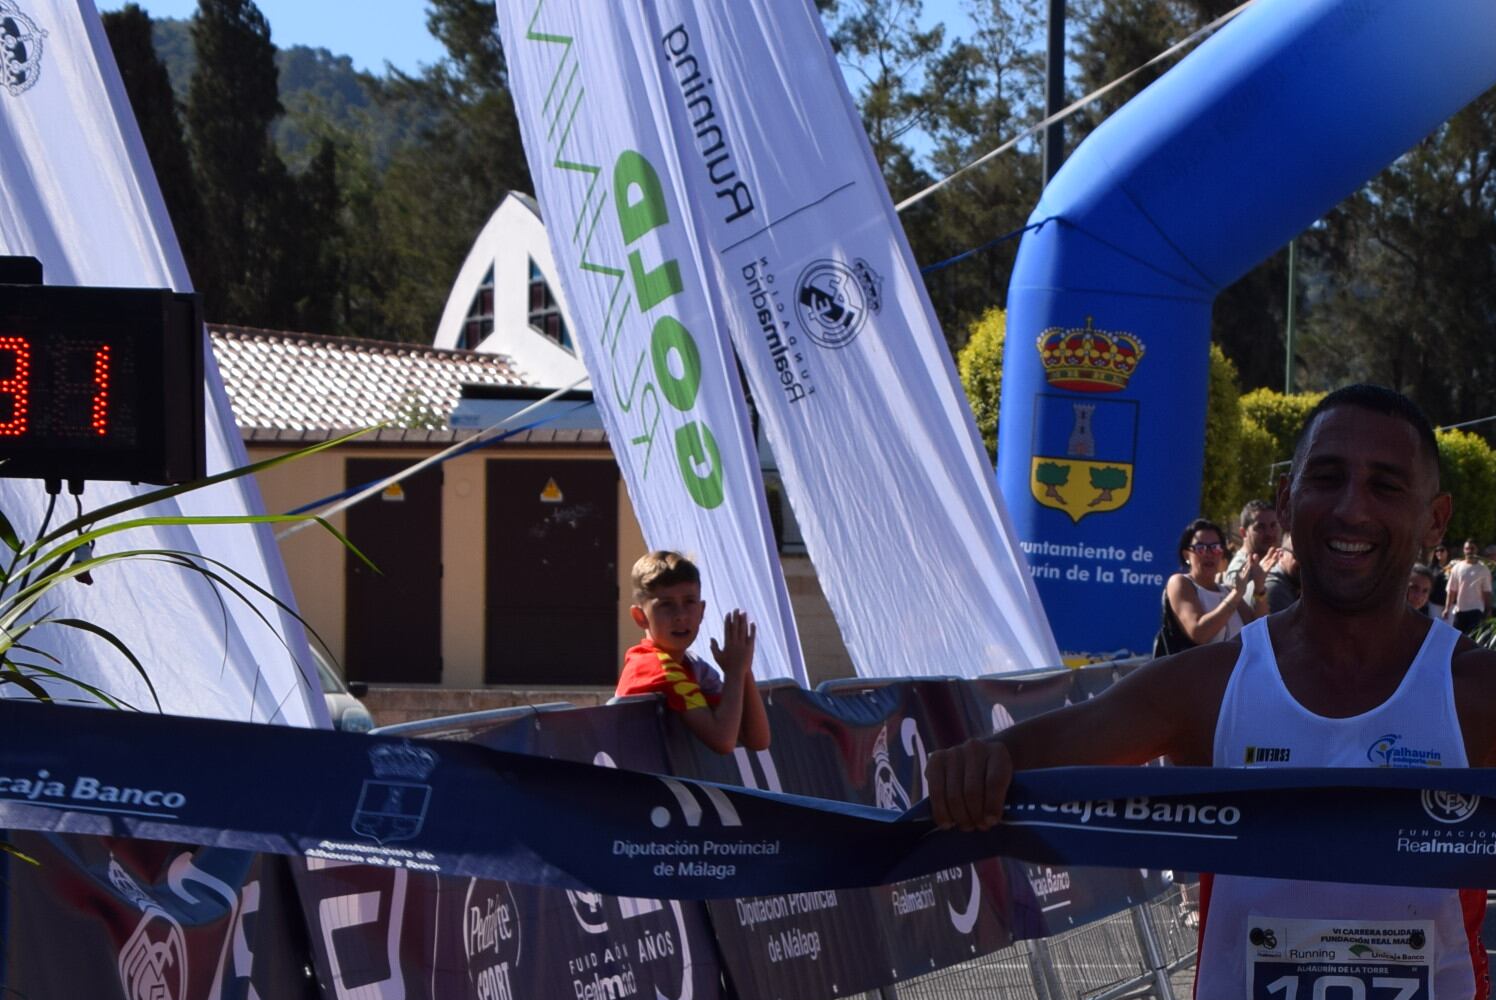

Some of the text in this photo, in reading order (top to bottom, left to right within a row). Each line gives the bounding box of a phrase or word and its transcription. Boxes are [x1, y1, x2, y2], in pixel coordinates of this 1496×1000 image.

[1020, 541, 1154, 563] untamiento de
[1066, 565, 1090, 582] de
[1097, 566, 1114, 583] la
[1120, 569, 1164, 586] Torre
[72, 776, 187, 808] Banco
[1124, 797, 1241, 826] Banco
[612, 840, 780, 858] Diputación Provincial
[653, 860, 736, 880] de Málaga
[1321, 935, 1371, 945] FUNDACIÓN
[1343, 928, 1382, 936] CARRERA
[638, 930, 674, 963] AÑOS
[768, 928, 821, 963] de Málaga
[1290, 949, 1336, 960] Running
[1363, 966, 1389, 974] TORRE
